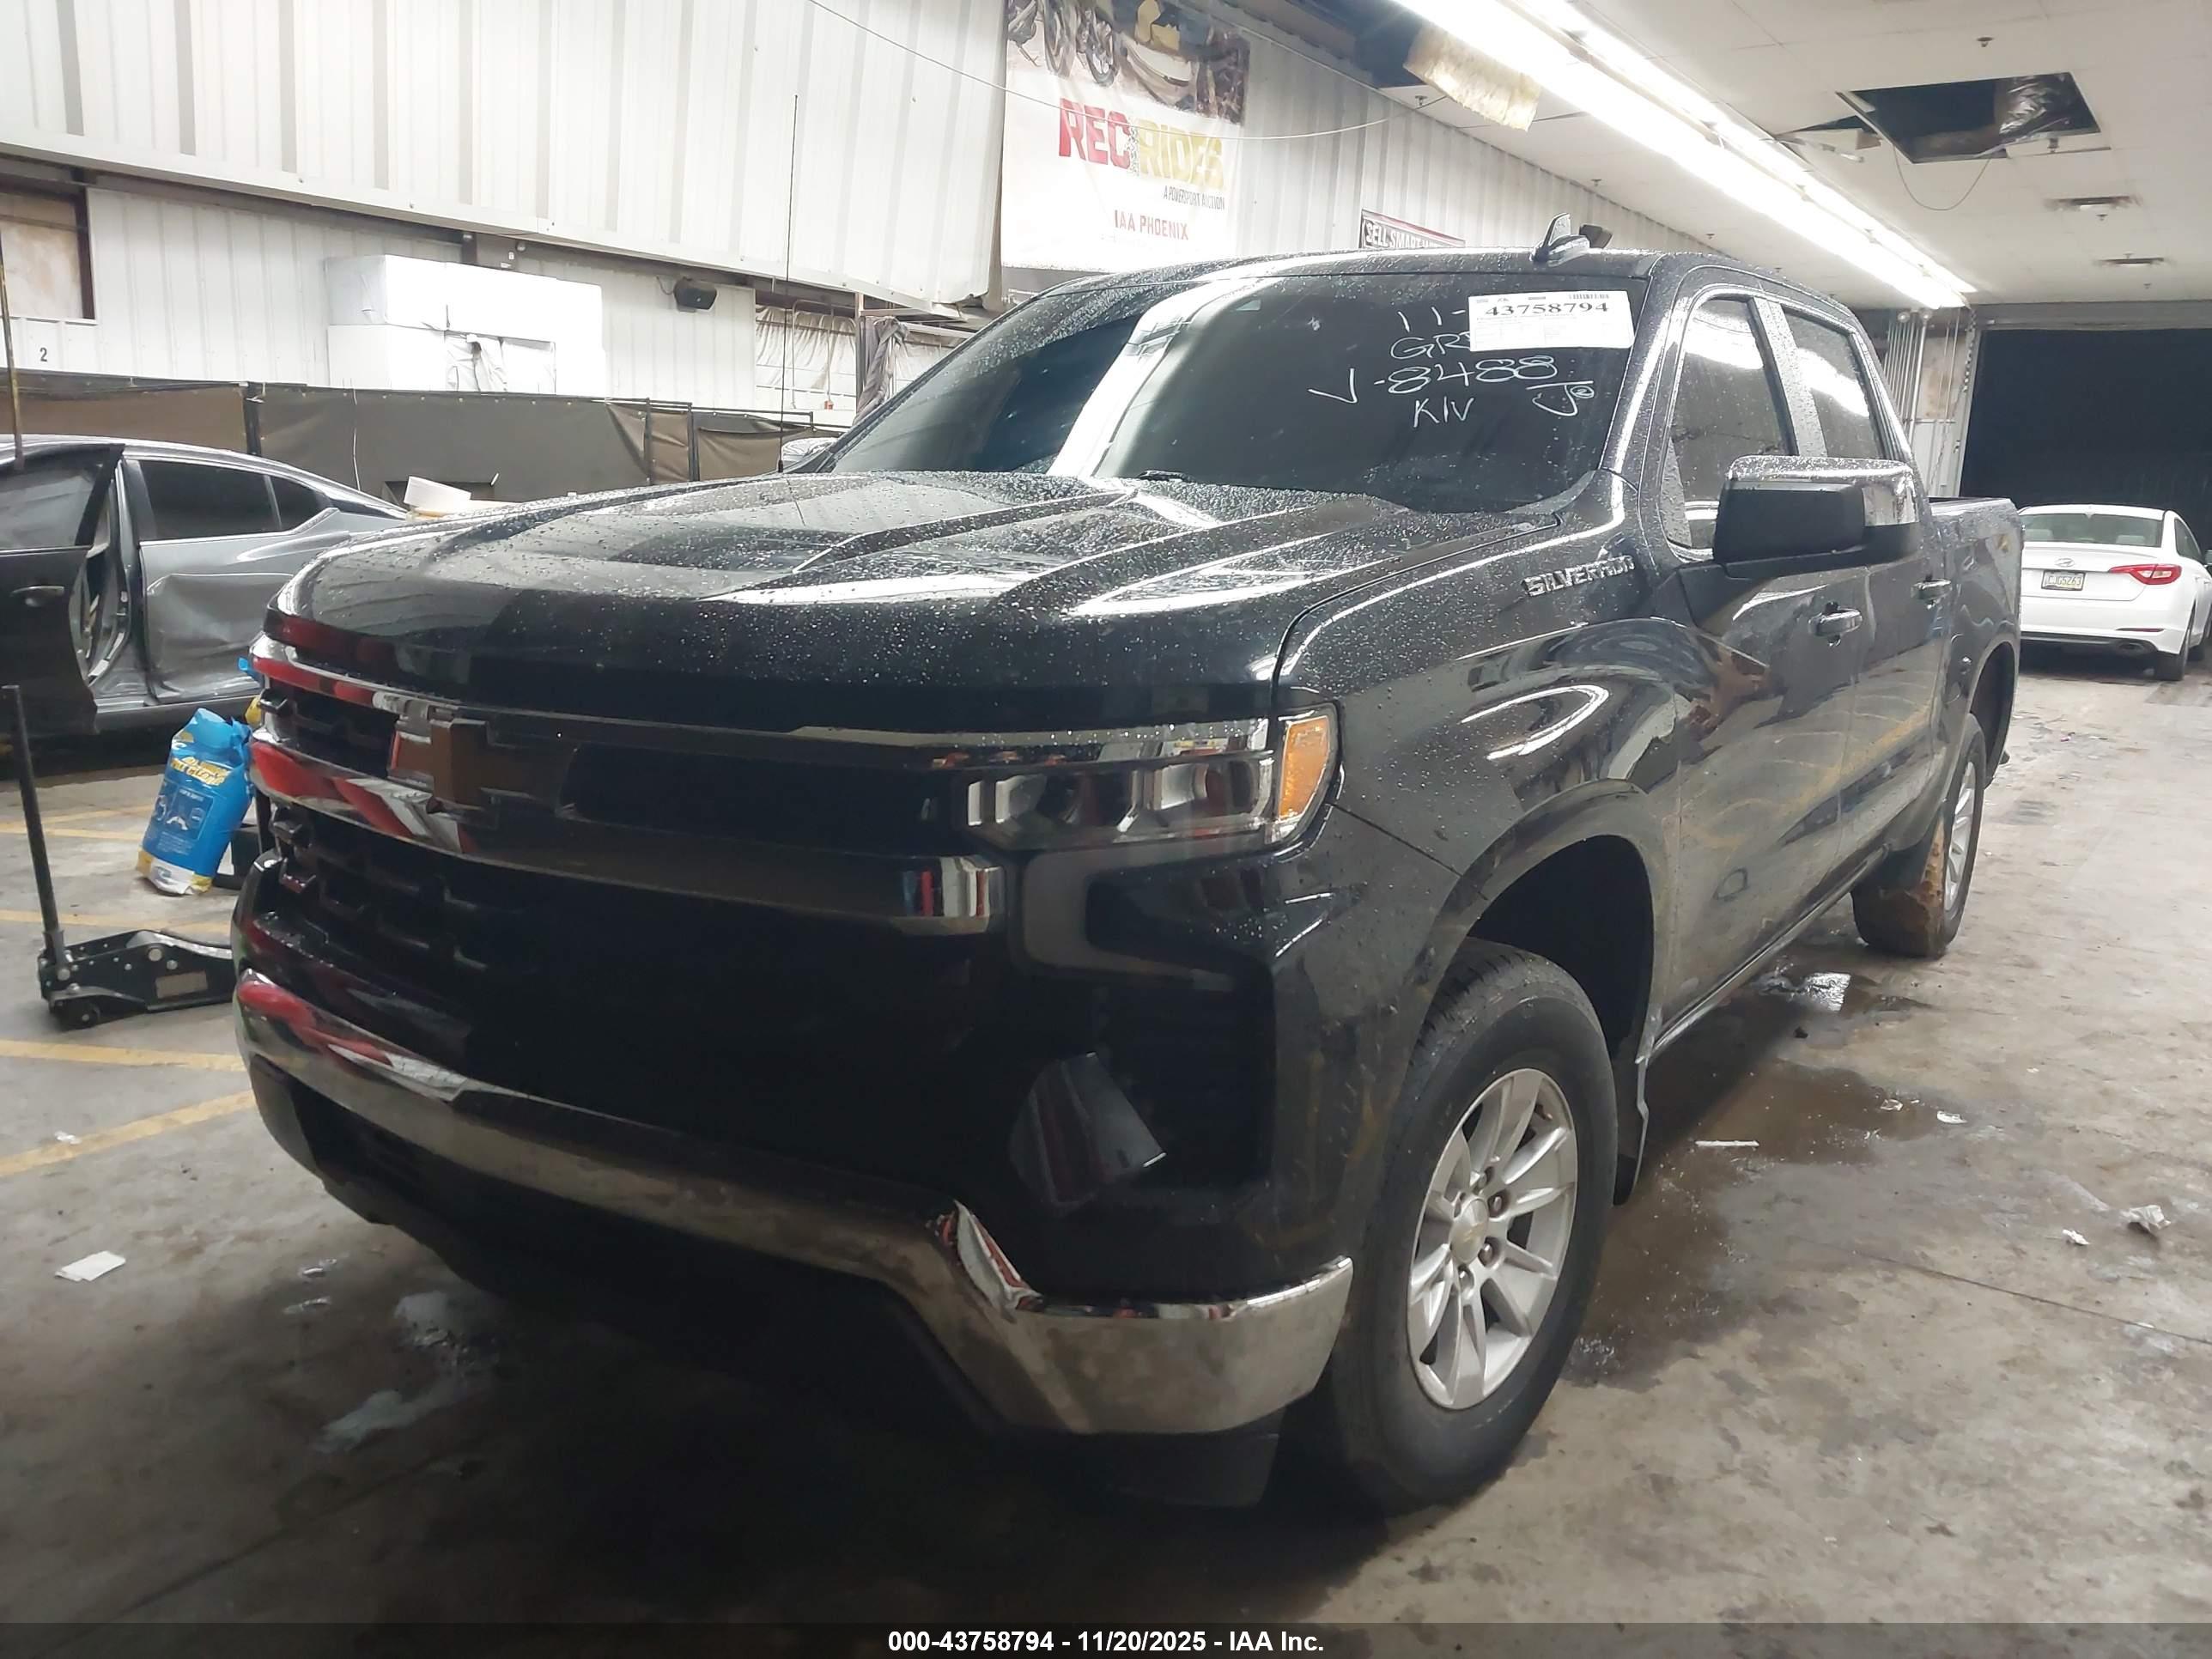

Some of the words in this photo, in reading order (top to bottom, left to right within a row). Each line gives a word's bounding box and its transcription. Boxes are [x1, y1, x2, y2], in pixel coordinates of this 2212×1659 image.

[1059, 97, 1130, 170] REC
[1138, 118, 1224, 190] RIDES
[1163, 185, 1168, 200] A
[1168, 186, 1200, 207] POWERSPORT
[1201, 193, 1225, 210] AUCTION
[1115, 210, 1135, 232] IAA
[1139, 215, 1188, 240] PHOENIX
[1365, 221, 1389, 247] SELL
[1485, 301, 1610, 317] 43758794
[40, 347, 48, 362] 2
